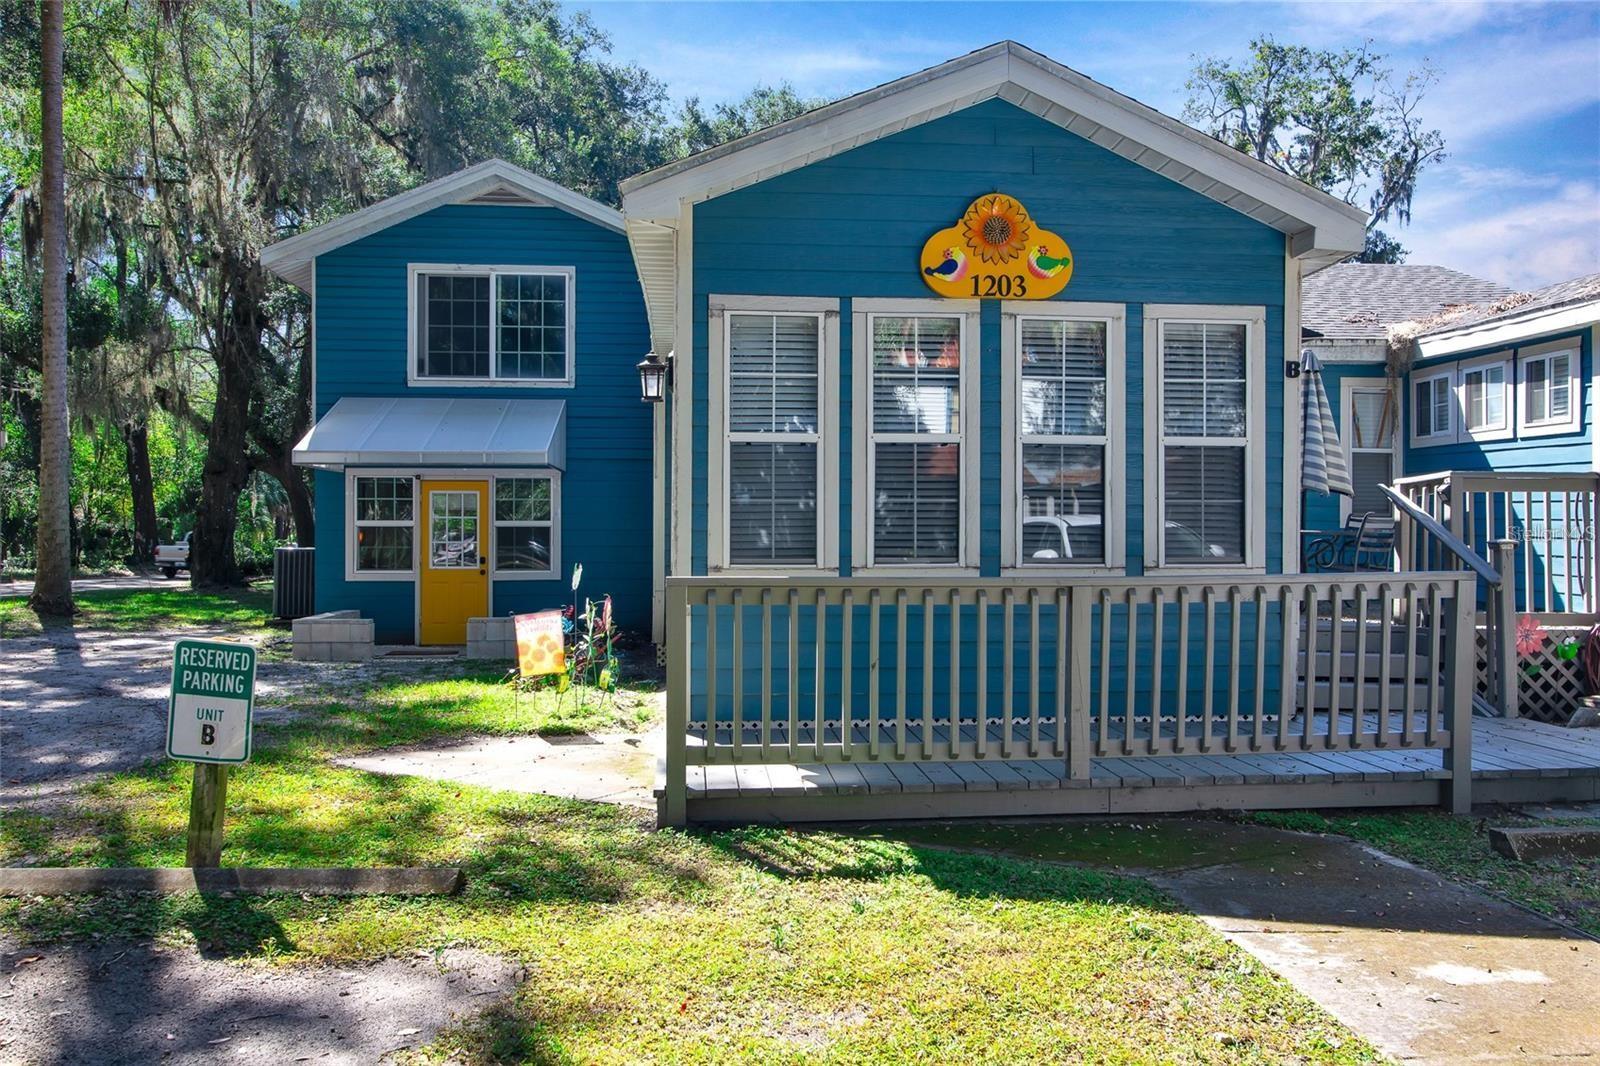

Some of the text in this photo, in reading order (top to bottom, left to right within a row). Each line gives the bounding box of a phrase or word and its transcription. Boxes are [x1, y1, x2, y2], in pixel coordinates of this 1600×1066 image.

[970, 274, 1027, 297] 1203
[1286, 361, 1301, 379] B
[180, 646, 250, 671] RESERVED
[182, 670, 245, 694] PARKING
[196, 707, 225, 722] UNIT
[201, 724, 216, 745] B
